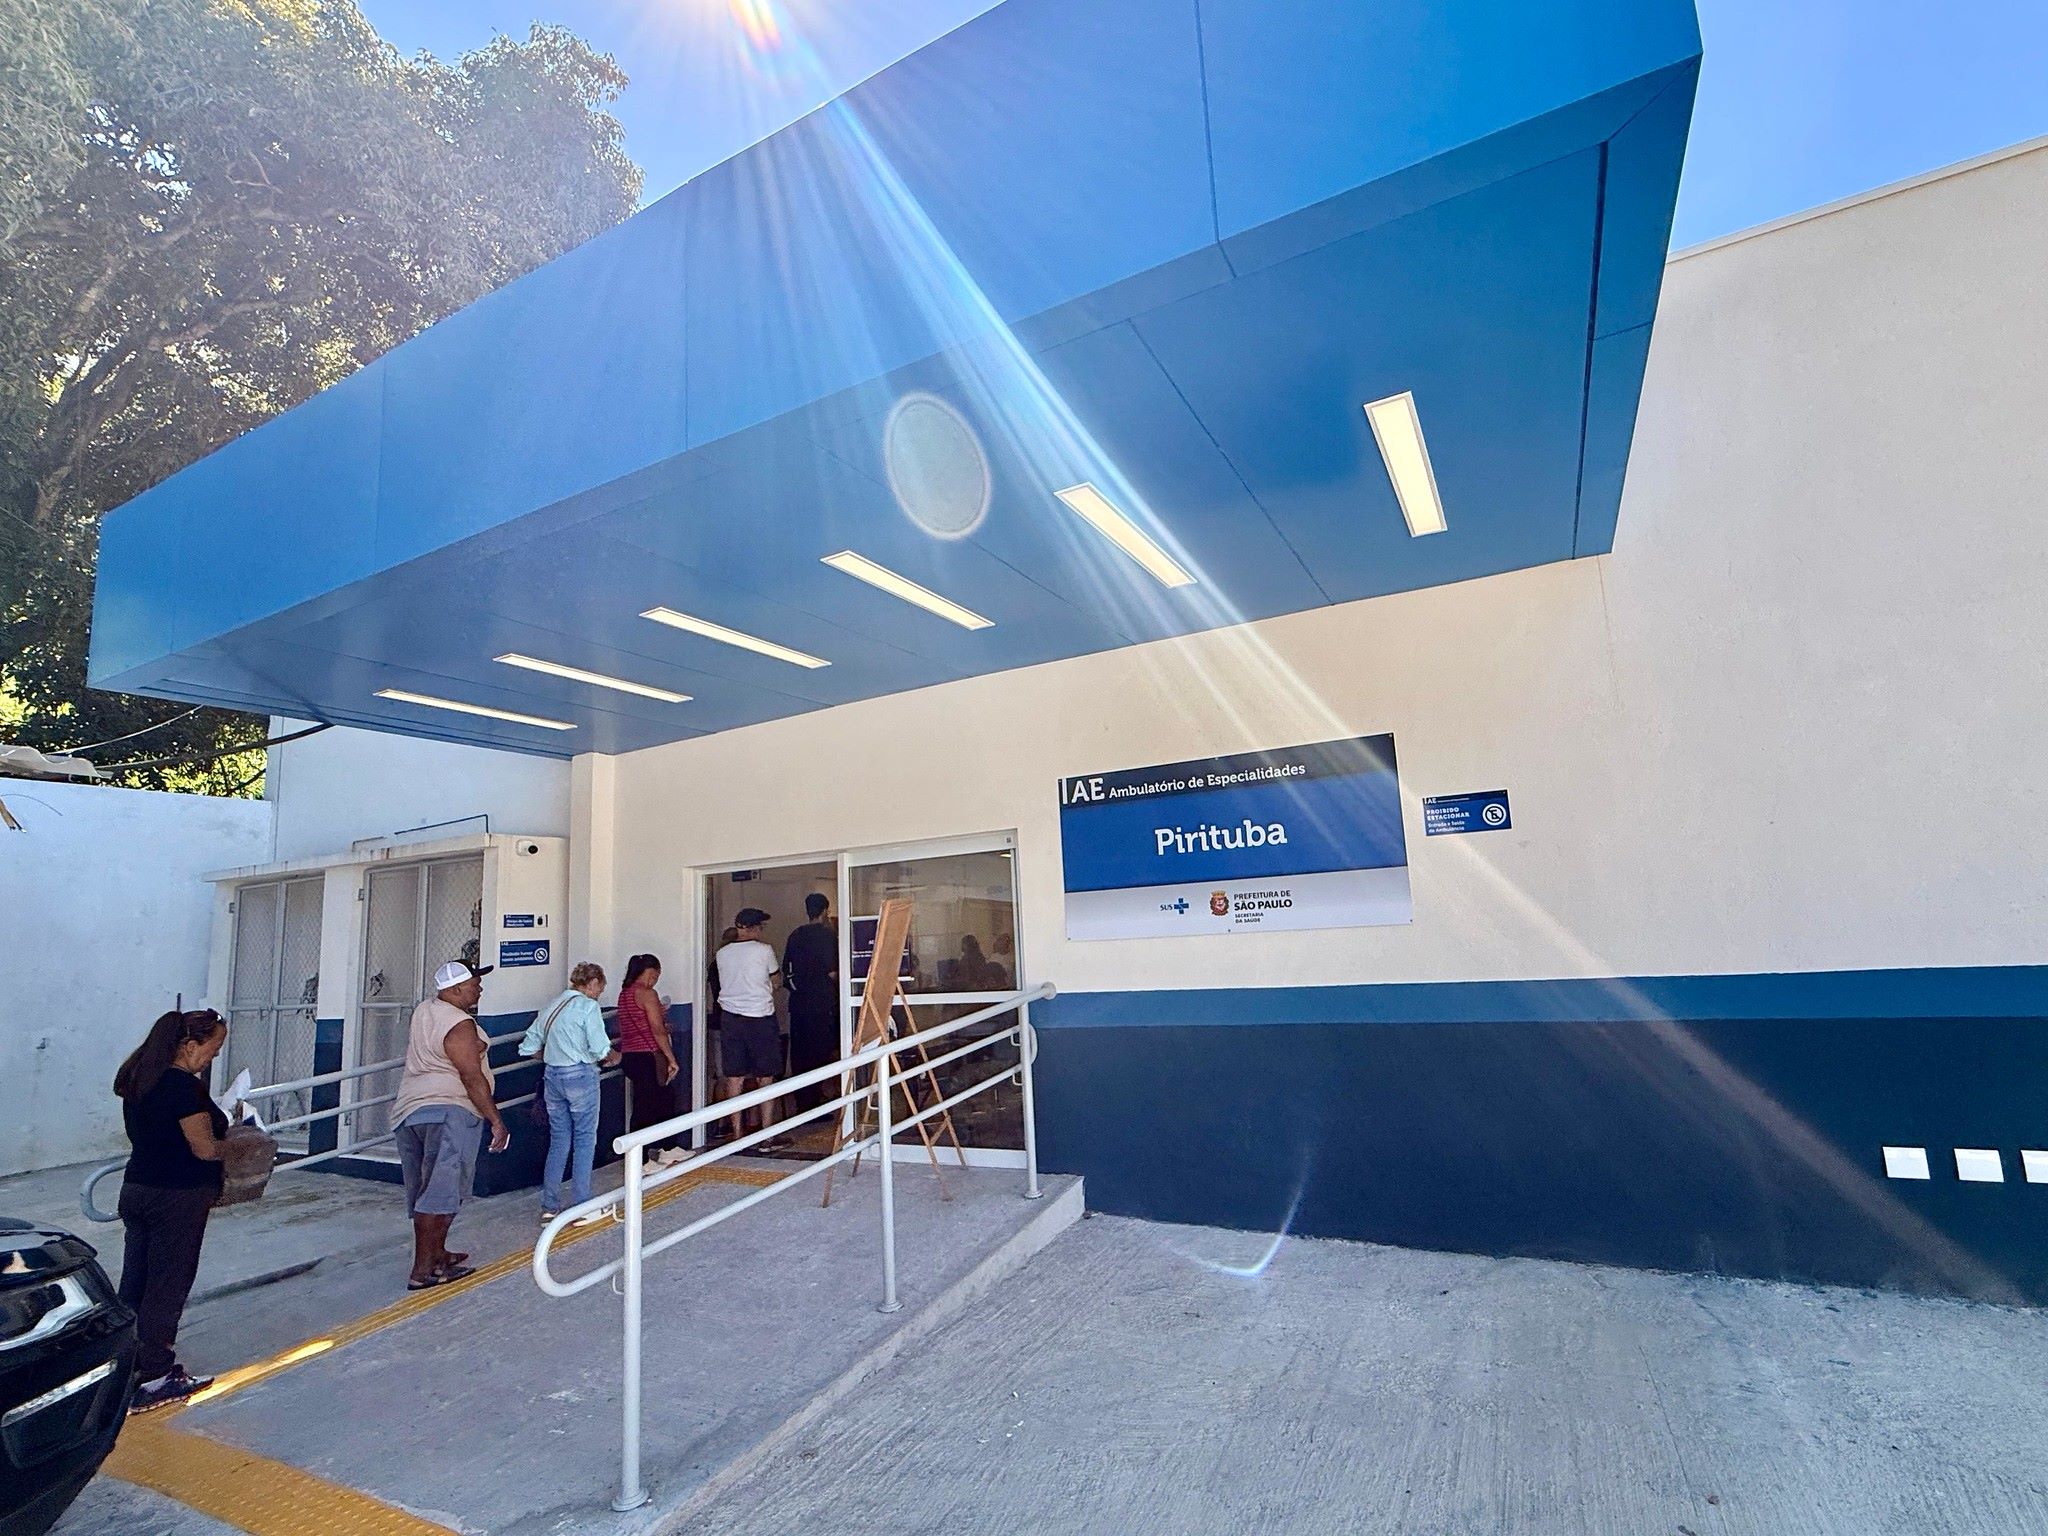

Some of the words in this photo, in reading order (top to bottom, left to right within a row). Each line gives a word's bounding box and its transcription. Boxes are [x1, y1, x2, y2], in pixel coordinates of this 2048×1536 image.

[1071, 777, 1105, 804] AE
[1109, 779, 1185, 799] Ambulatório
[1188, 775, 1204, 789] de
[1206, 763, 1306, 787] Especialidades
[1426, 807, 1460, 815] PROIBIDO
[1427, 812, 1470, 821] ESTACIONAR
[1154, 819, 1288, 856] Pirituba
[1234, 891, 1279, 900] PREFEITURA
[1234, 900, 1256, 911] SÃO
[1257, 899, 1293, 910] PAULO
